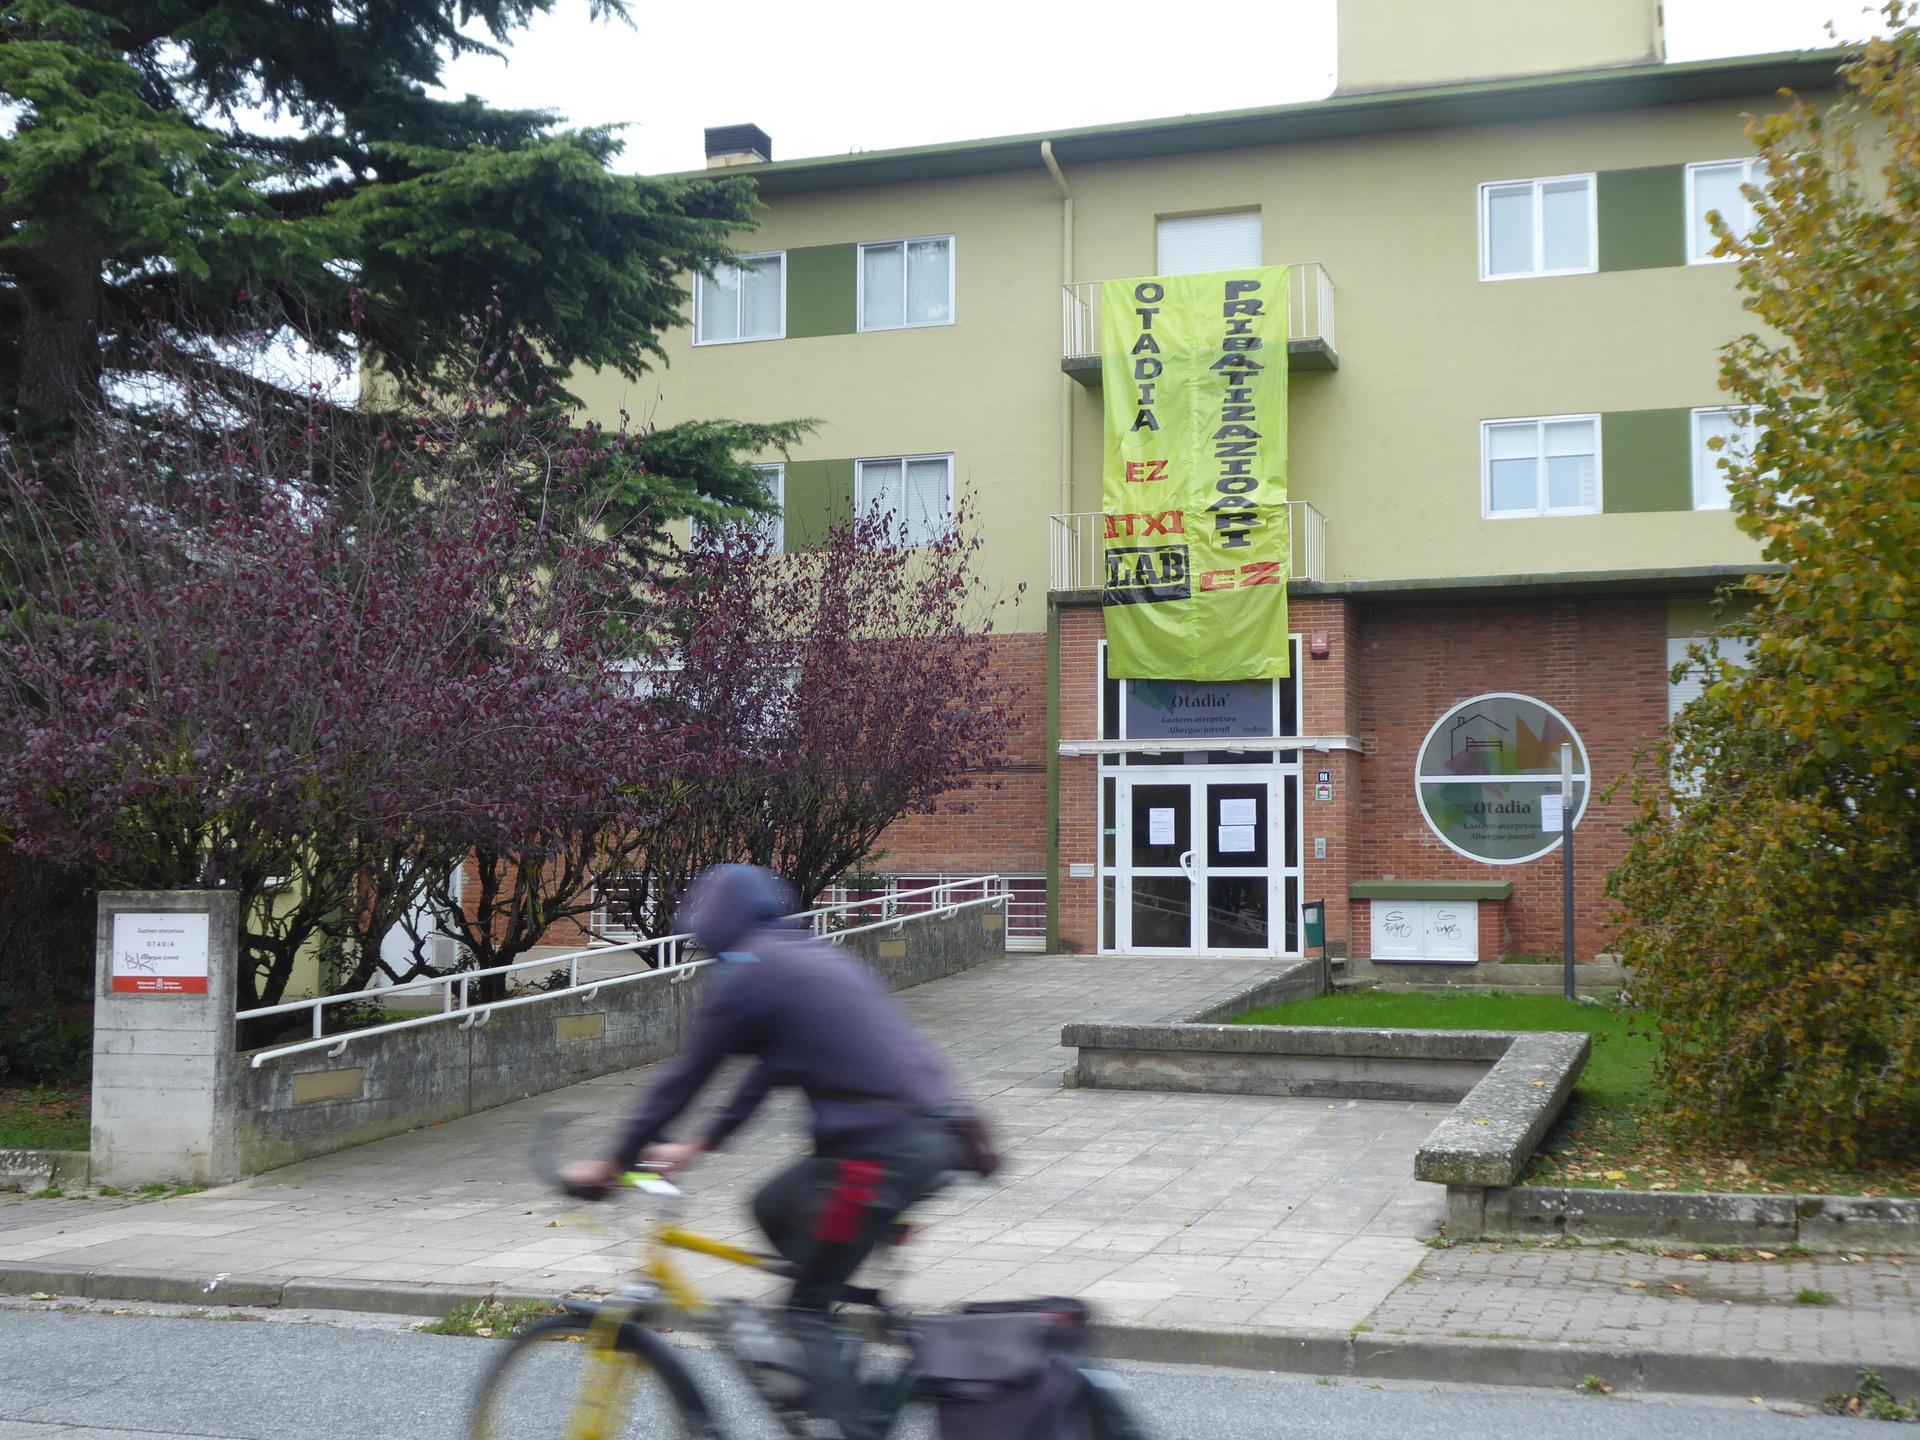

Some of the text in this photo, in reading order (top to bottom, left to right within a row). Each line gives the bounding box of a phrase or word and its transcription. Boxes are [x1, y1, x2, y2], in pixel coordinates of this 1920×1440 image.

[1130, 282, 1164, 432] OTADIA
[1205, 280, 1266, 549] PRIBATIZAZIOARI
[1126, 459, 1169, 483] EZ
[1103, 511, 1185, 539] ITXI
[1107, 552, 1185, 588] LAB
[1200, 561, 1280, 593] EZ
[1172, 693, 1226, 708] Otadia
[1168, 725, 1230, 735] Albergue juvenil
[1319, 772, 1328, 781] 91
[1473, 800, 1531, 814] Otadia
